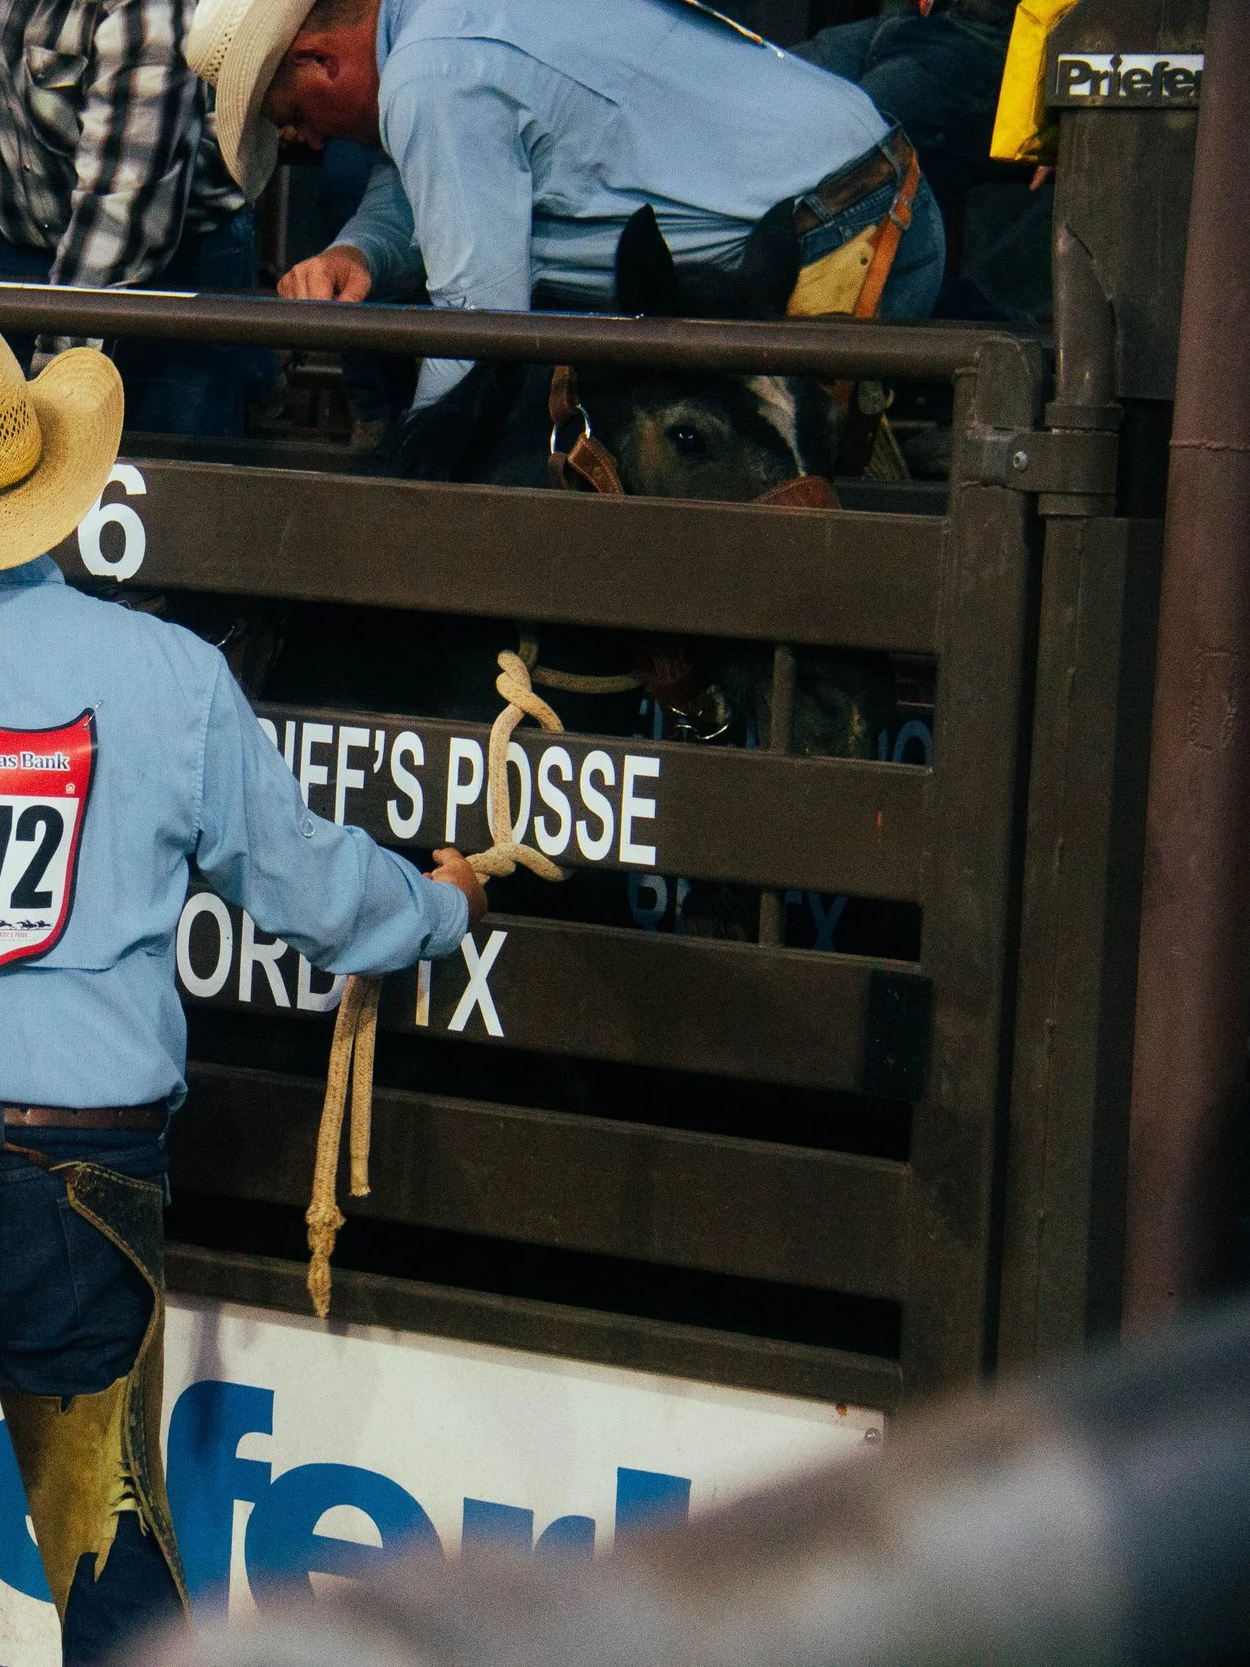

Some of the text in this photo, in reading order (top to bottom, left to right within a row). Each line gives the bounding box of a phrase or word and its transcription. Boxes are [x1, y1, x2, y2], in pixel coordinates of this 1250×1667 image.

[1057, 54, 1204, 98] Priefe
[77, 464, 147, 582] 6
[20, 752, 70, 771] Bank
[445, 737, 660, 866] POSSE
